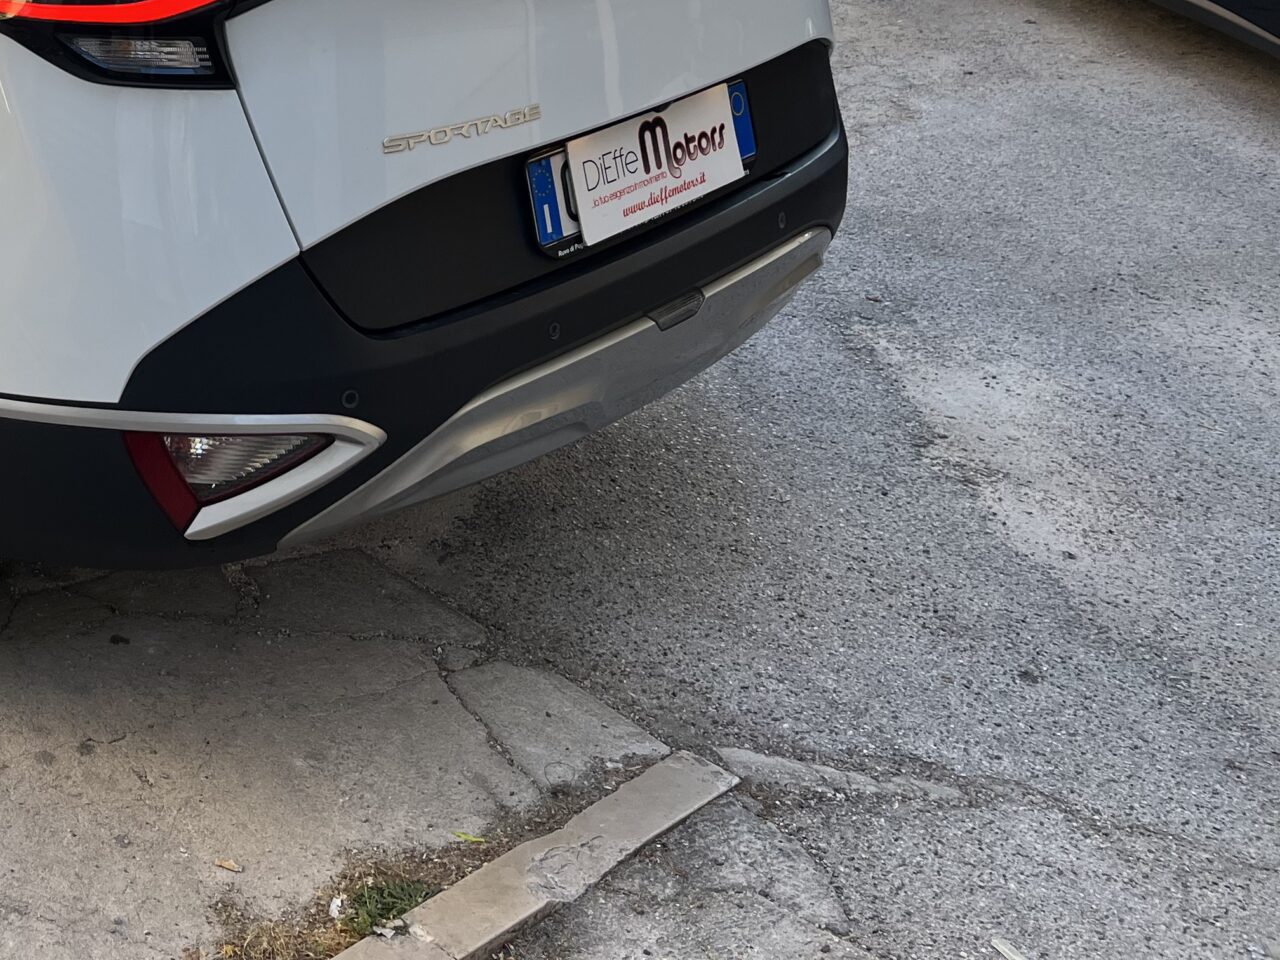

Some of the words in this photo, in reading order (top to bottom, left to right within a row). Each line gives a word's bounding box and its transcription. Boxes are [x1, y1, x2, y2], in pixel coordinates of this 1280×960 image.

[382, 103, 543, 155] SPORTAGE
[582, 146, 639, 192] DiEffe
[637, 115, 726, 179] Motors
[623, 171, 707, 218] www.dieffemotors.it
